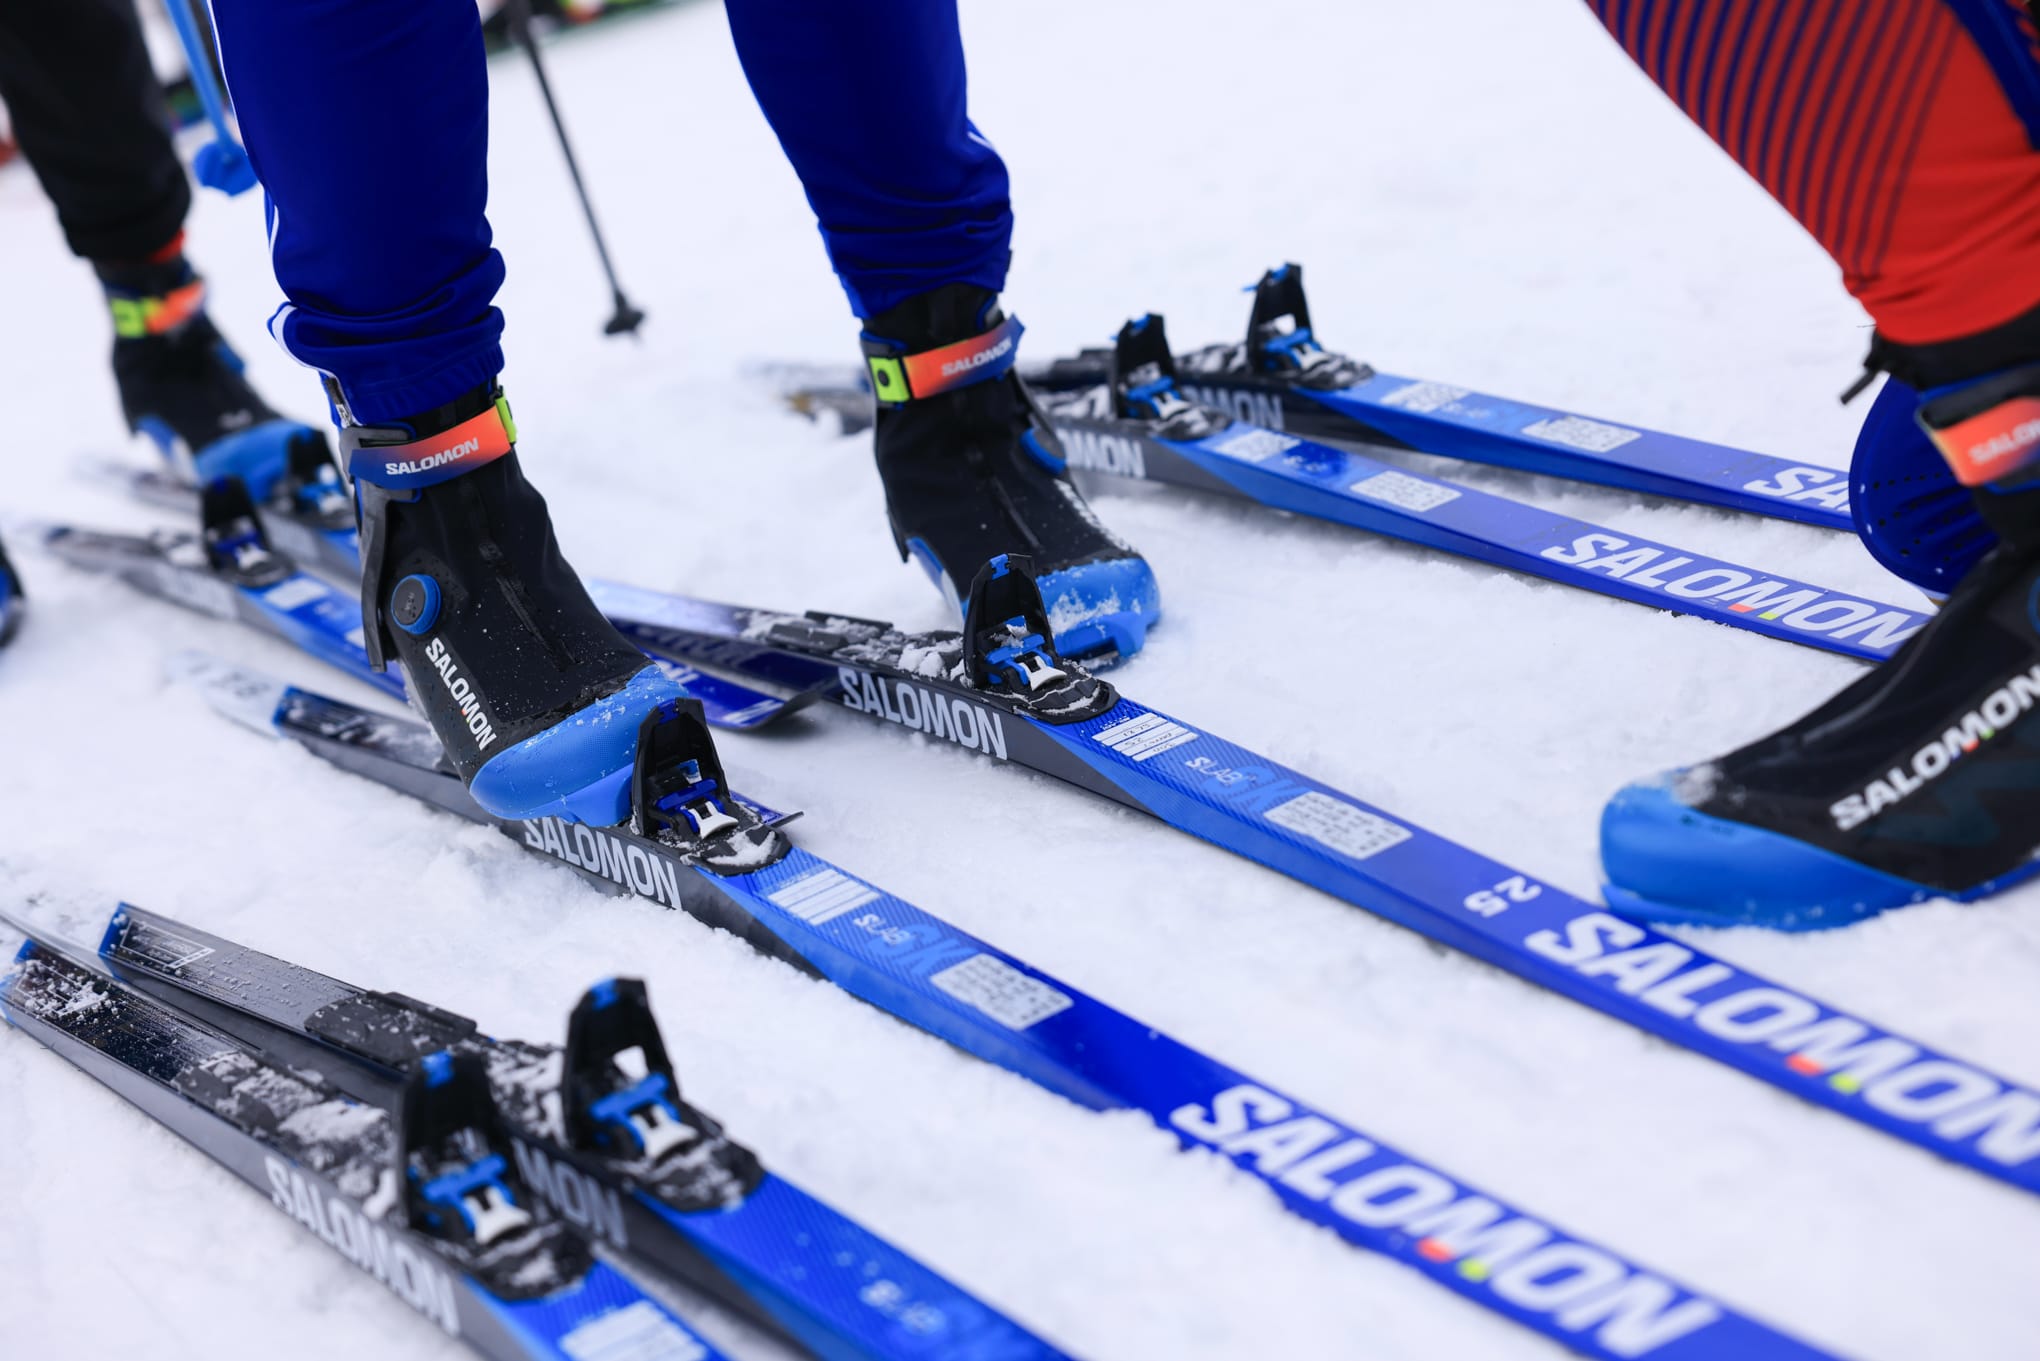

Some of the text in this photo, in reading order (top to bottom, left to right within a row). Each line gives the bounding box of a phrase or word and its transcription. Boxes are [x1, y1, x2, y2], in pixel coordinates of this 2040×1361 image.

[386, 438, 480, 476] SALOMON
[1743, 466, 1851, 512] SA
[1540, 533, 1921, 649] SALOMON
[425, 638, 498, 751] SALOMON
[838, 666, 1008, 760] SALOMON
[1830, 665, 2040, 831] SALOMON
[525, 817, 683, 910] SALOMON
[1524, 912, 2040, 1166] SALOMON
[264, 1155, 461, 1337] SALOMON
[1169, 1083, 1722, 1358] SALOMON
